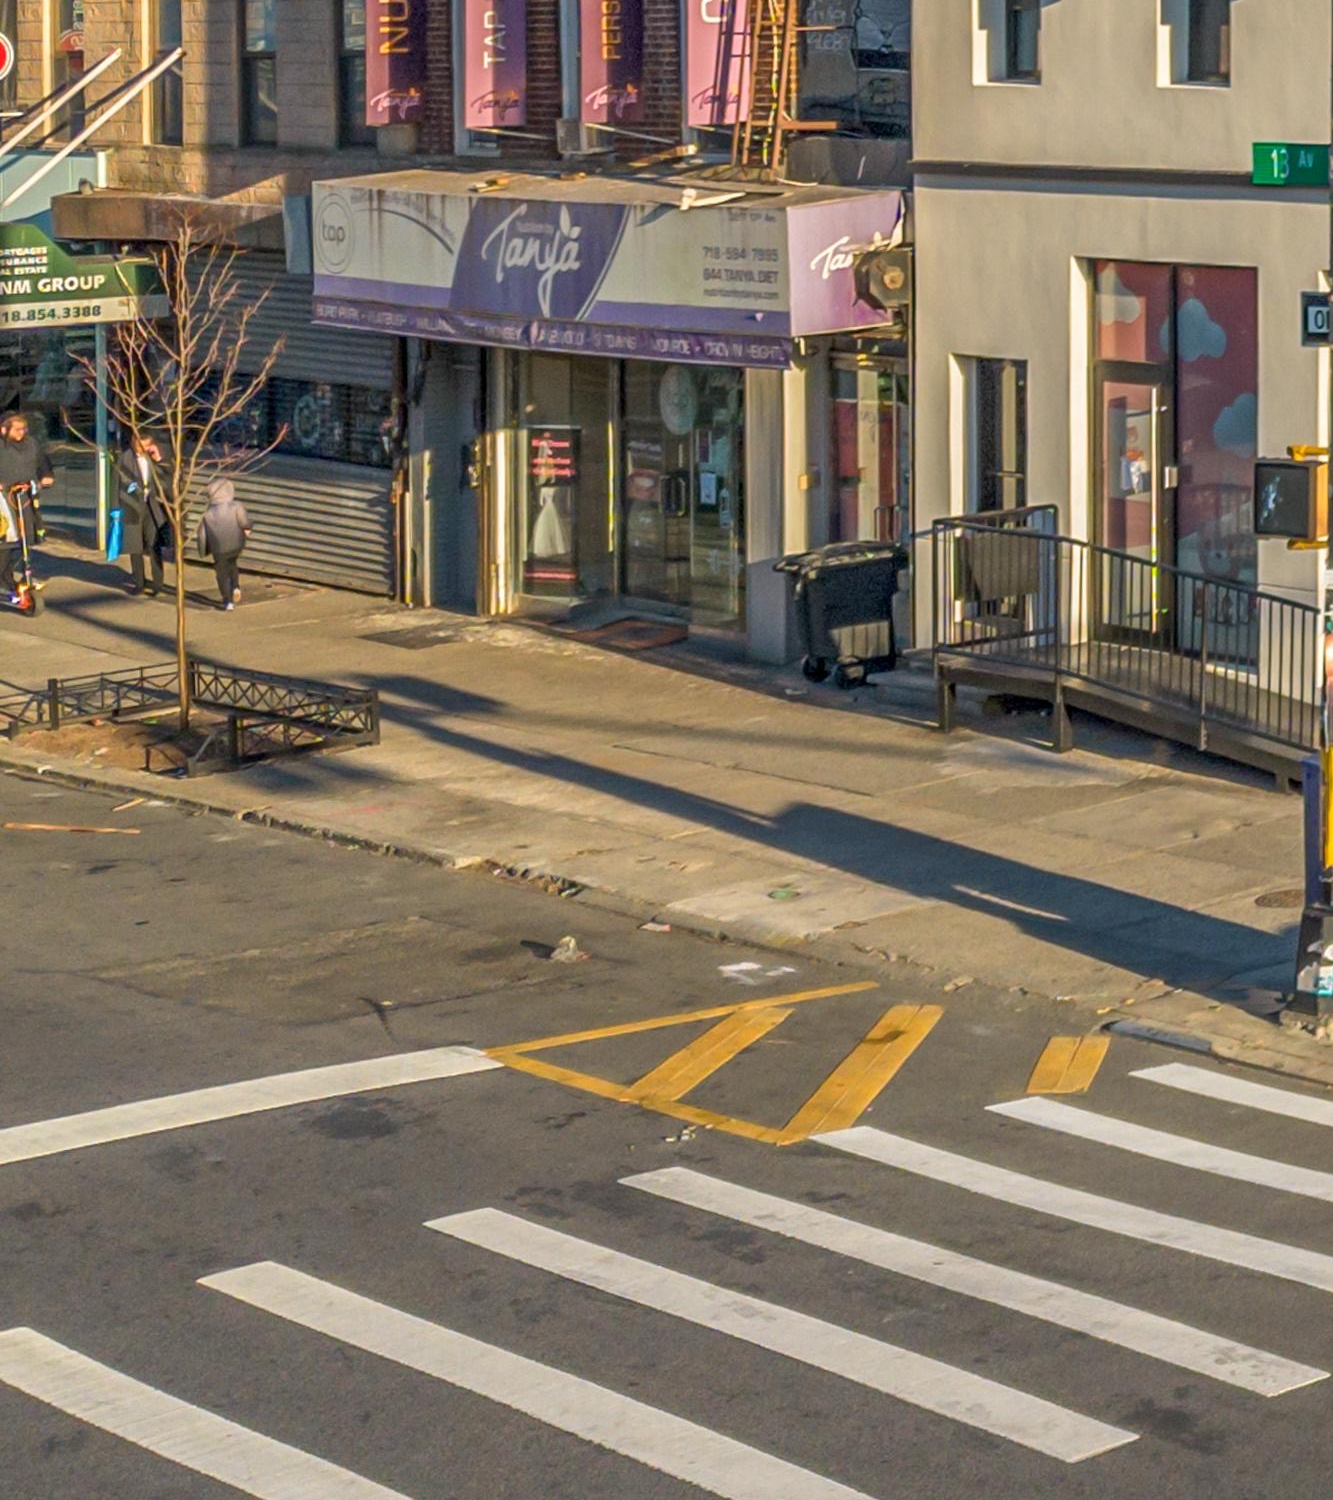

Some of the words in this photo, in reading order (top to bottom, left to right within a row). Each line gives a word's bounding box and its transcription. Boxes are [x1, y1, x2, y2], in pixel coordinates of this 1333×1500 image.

[483, 9, 506, 69] TAP
[322, 220, 346, 246] tap
[481, 203, 582, 318] Tanya
[37, 274, 105, 293] GROUP
[2, 305, 101, 323] 18.854.3388
